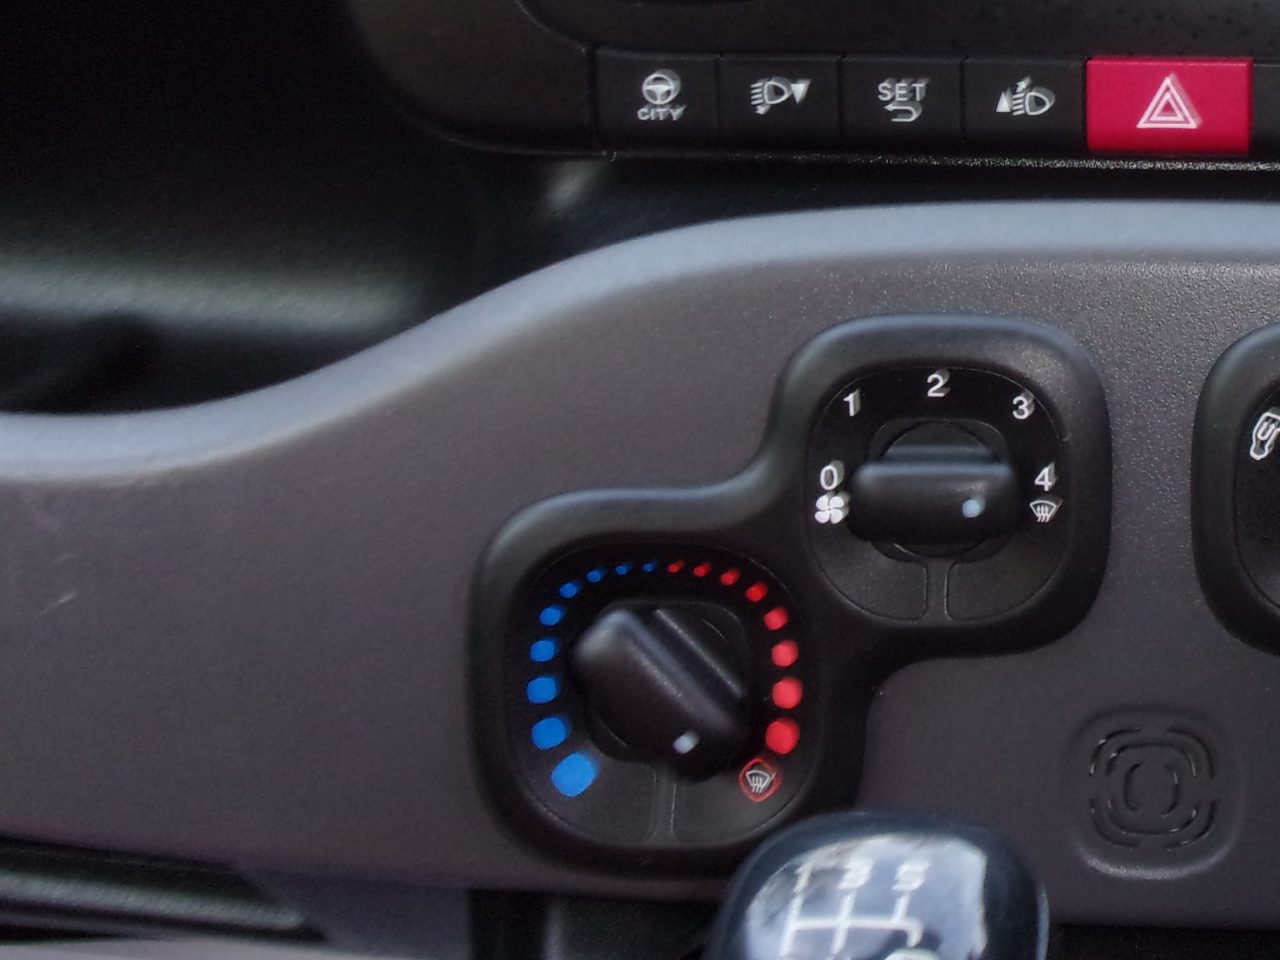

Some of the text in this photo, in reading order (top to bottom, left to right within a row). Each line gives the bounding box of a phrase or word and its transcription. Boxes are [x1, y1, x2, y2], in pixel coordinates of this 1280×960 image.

[877, 80, 927, 102] SET
[637, 106, 686, 121] CITY
[926, 372, 947, 398] 2
[843, 391, 859, 417] 1
[1012, 394, 1033, 420] 3
[820, 463, 842, 490] 0
[1034, 464, 1055, 491] 4
